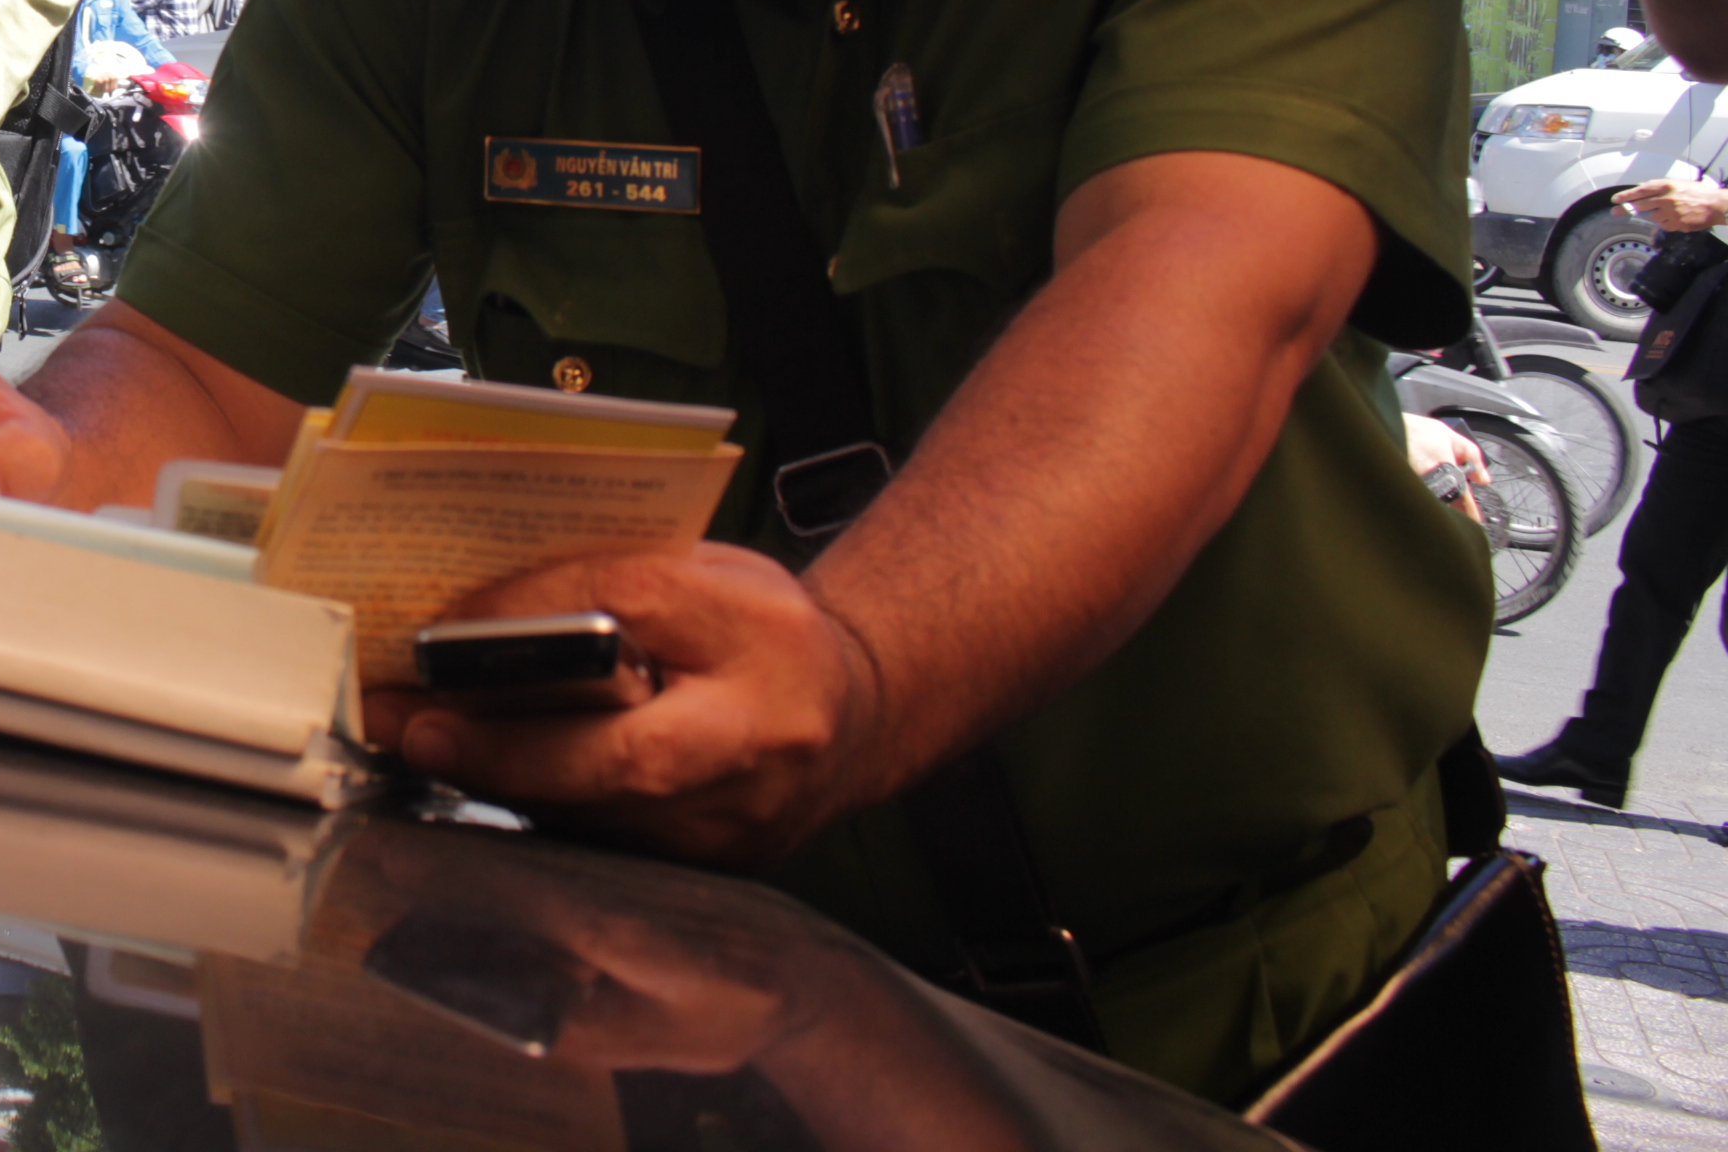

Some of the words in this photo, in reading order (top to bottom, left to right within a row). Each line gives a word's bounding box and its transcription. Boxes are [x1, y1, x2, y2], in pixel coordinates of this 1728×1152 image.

[621, 155, 652, 178] VĂN
[654, 158, 679, 179] TRÍ
[566, 180, 604, 199] 261
[625, 183, 668, 203] 544
